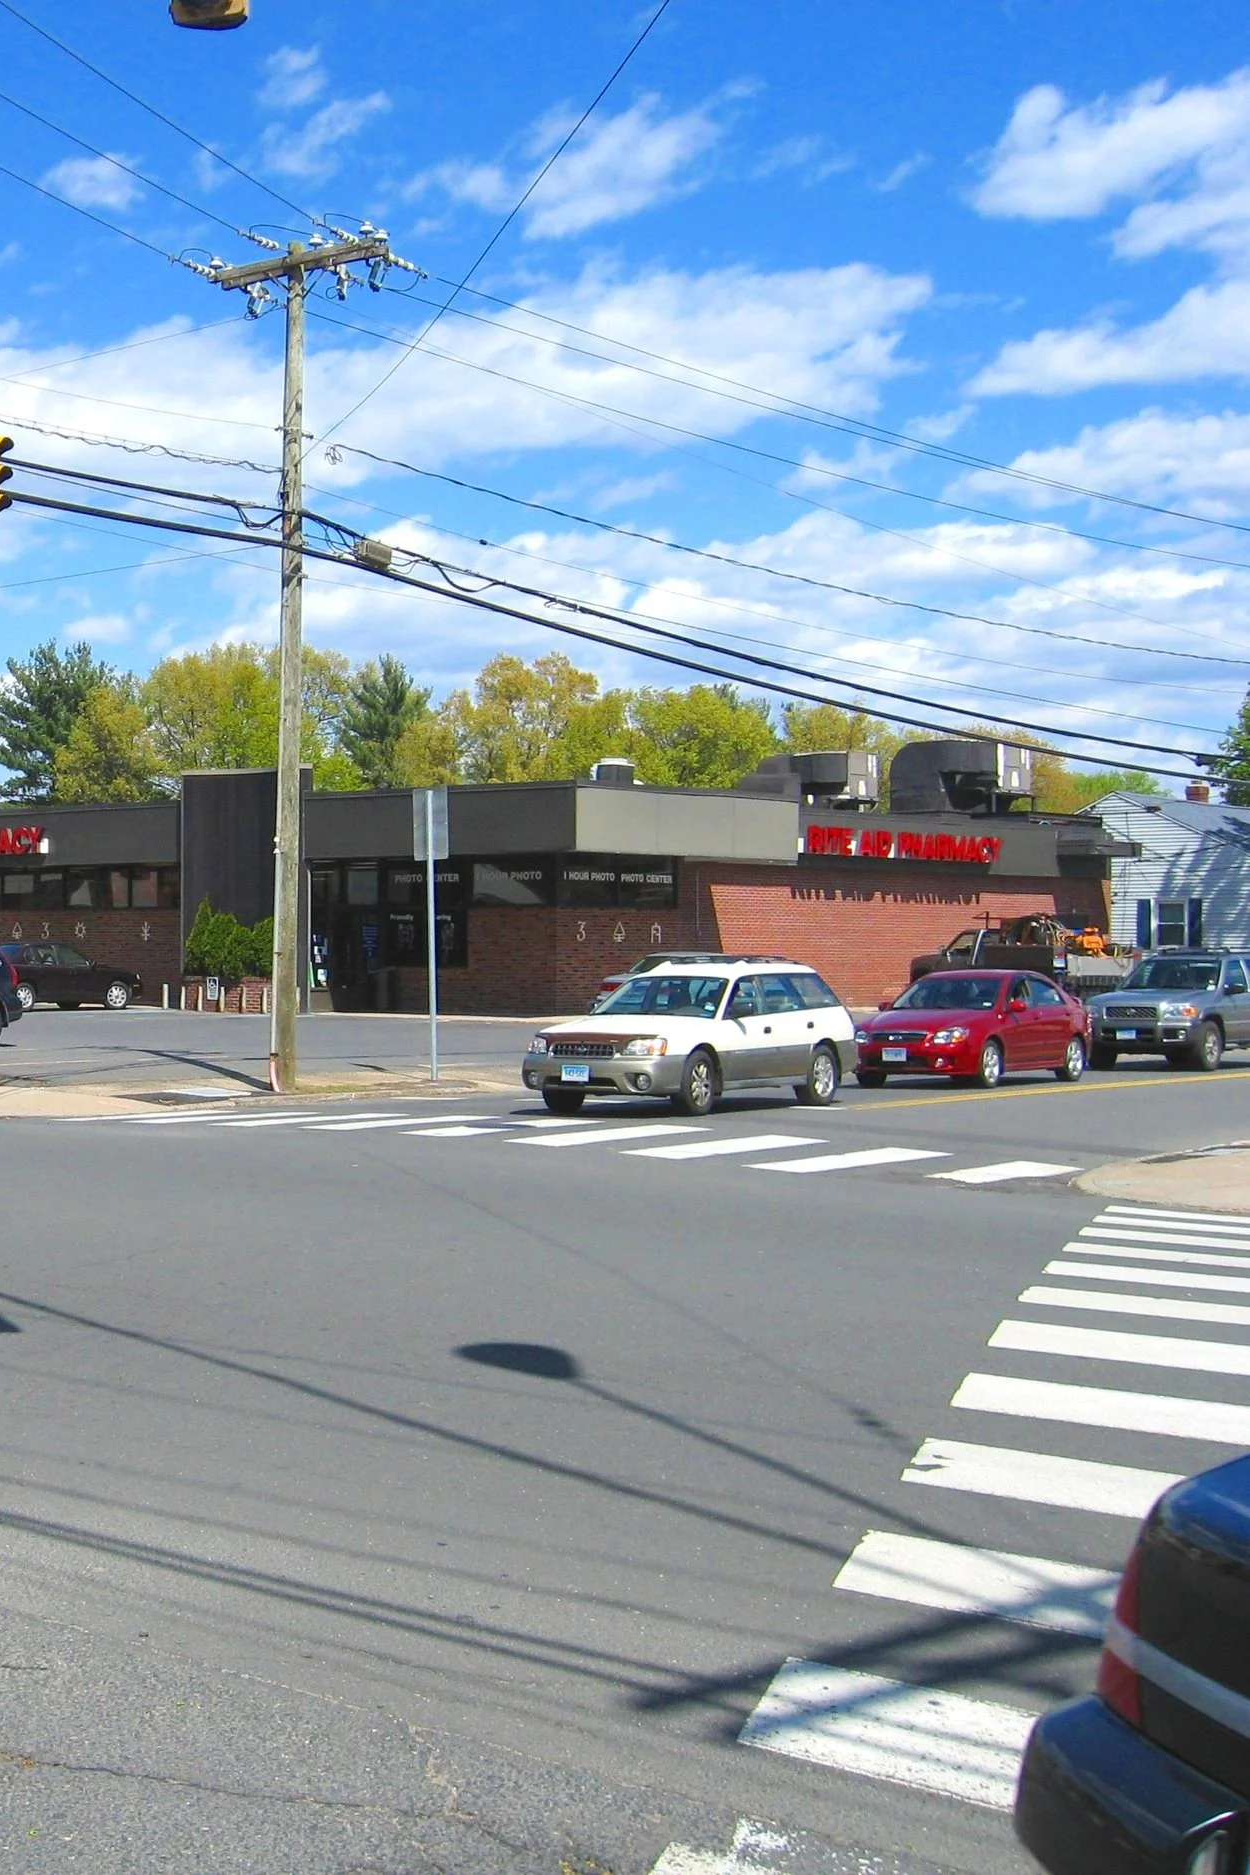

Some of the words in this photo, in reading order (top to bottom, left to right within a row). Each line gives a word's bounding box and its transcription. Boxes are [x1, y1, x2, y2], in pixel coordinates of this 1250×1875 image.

[807, 825, 855, 855] RITE
[859, 829, 891, 857] AID
[897, 831, 1003, 863] PHARMACY
[394, 874, 422, 883] PHOTO
[510, 870, 543, 880] PHOTO
[569, 871, 590, 881] HOUR
[590, 872, 616, 882] PHOTO
[620, 873, 644, 883] PHOTO
[646, 873, 673, 884] CENTER
